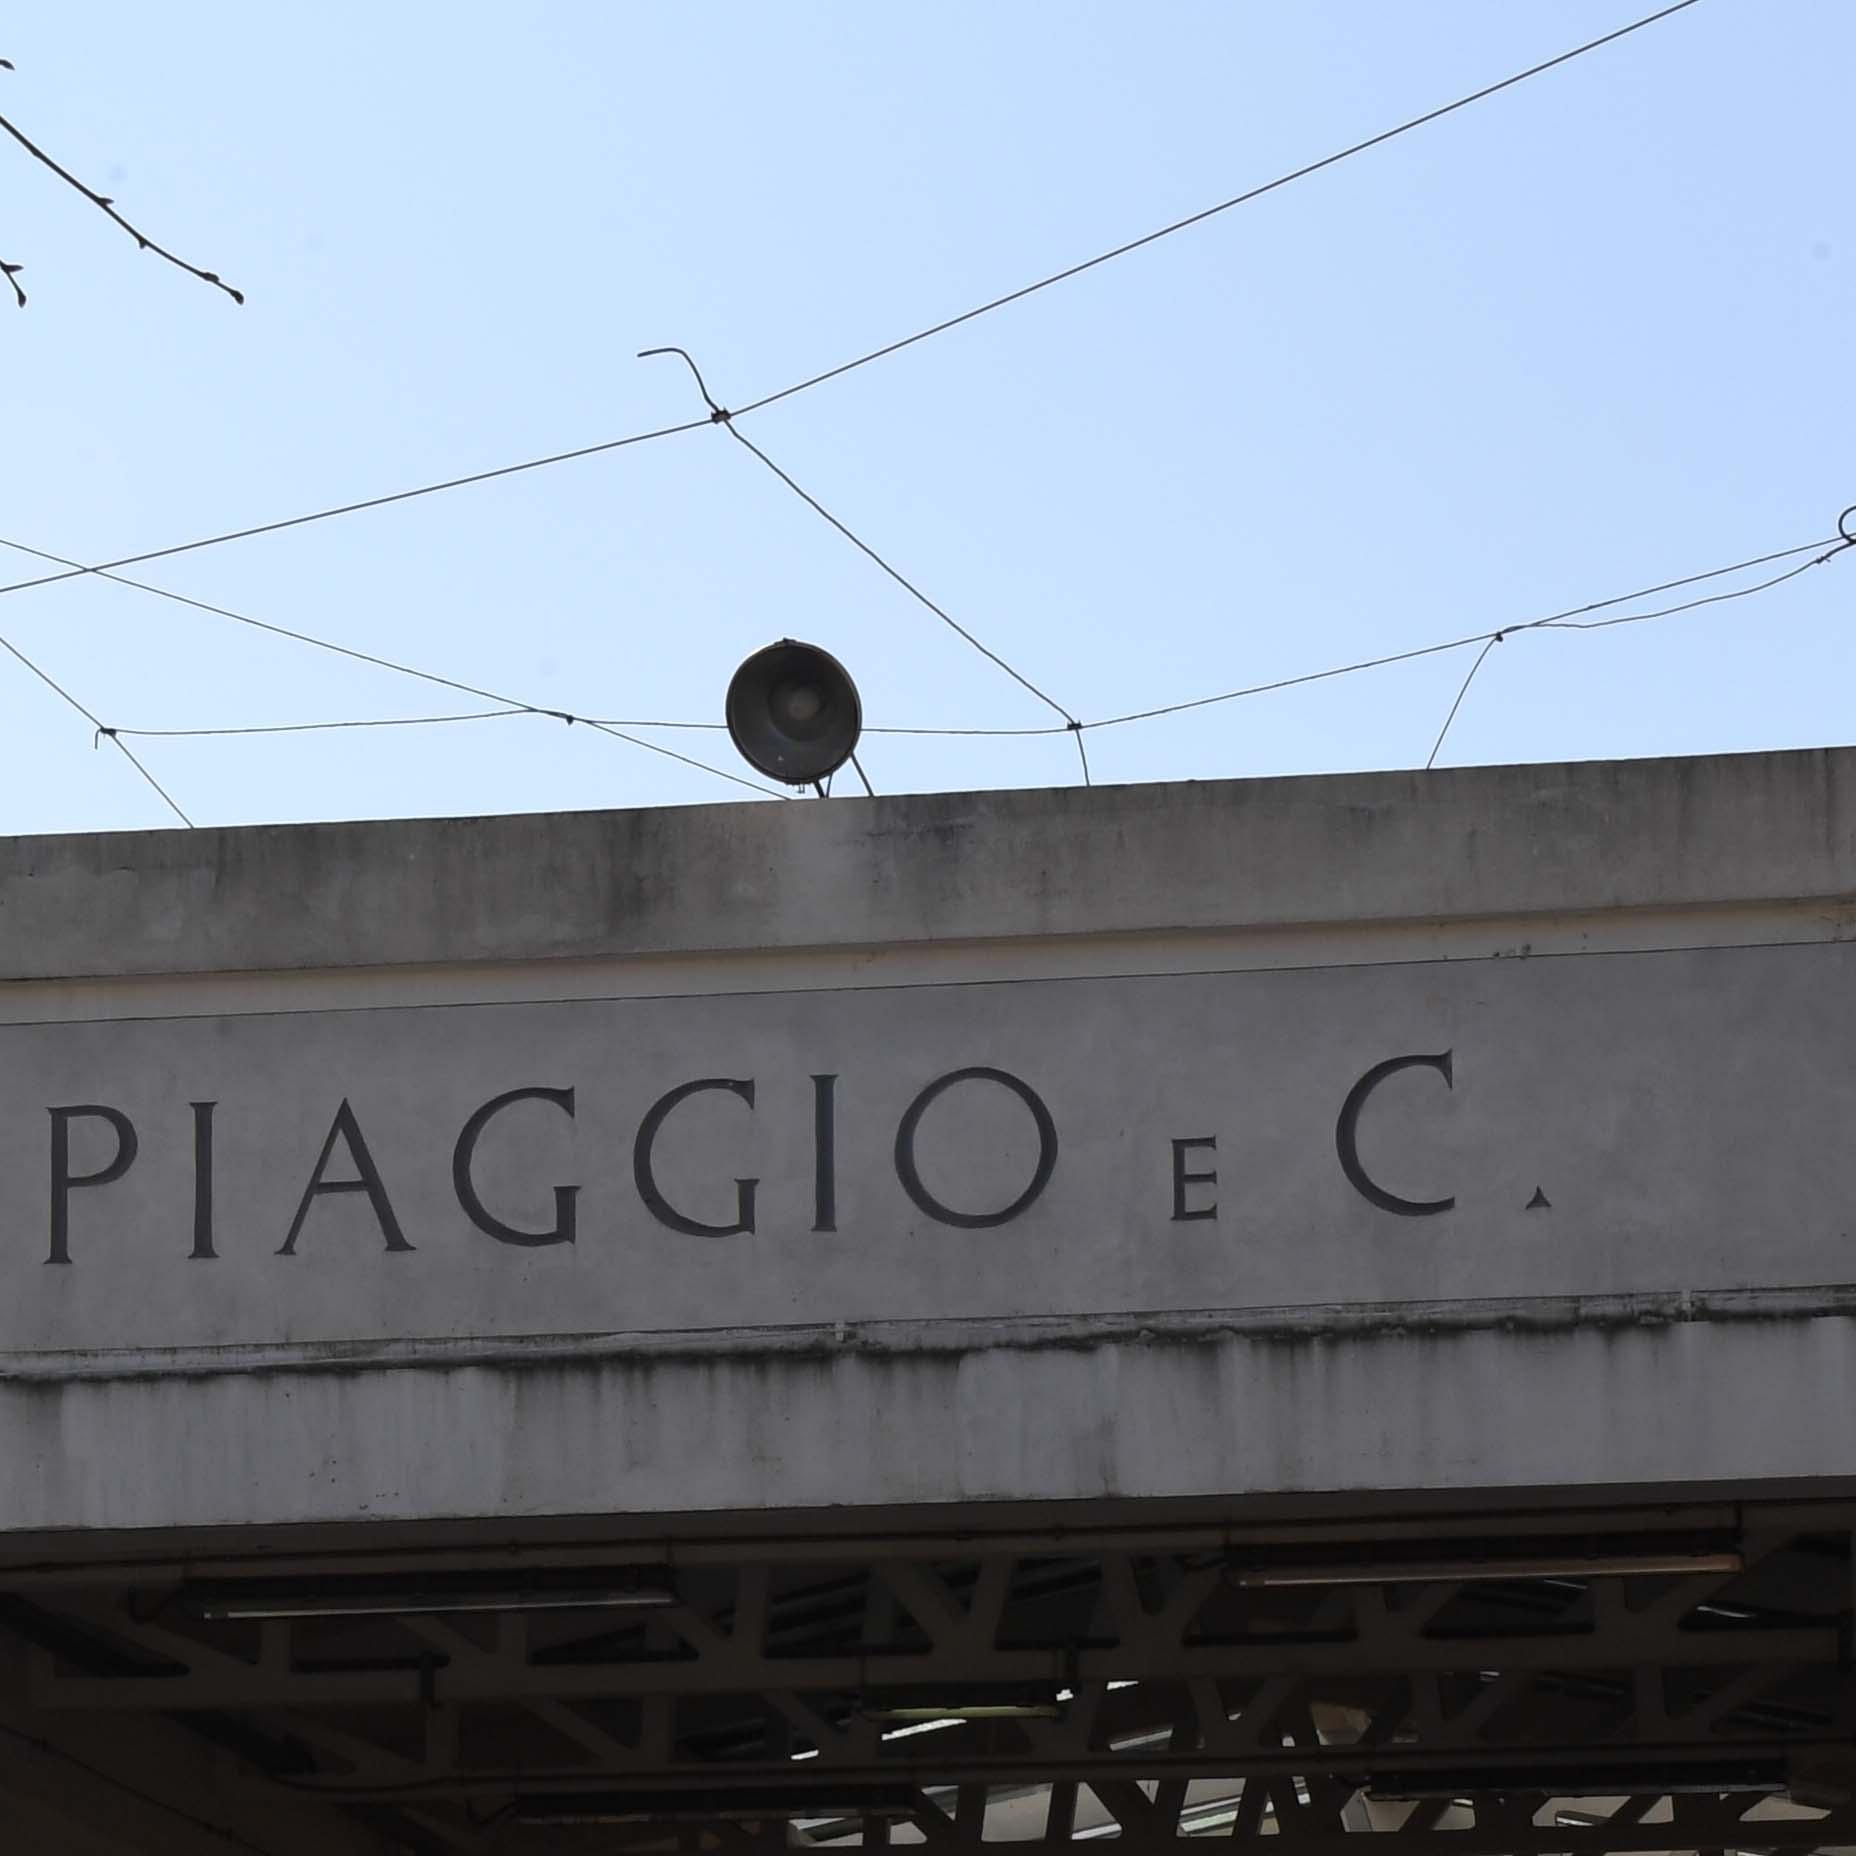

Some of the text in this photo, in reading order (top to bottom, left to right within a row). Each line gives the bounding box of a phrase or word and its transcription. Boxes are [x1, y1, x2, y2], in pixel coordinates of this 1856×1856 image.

[43, 1050, 1555, 1265] PIAGGIO E C.
